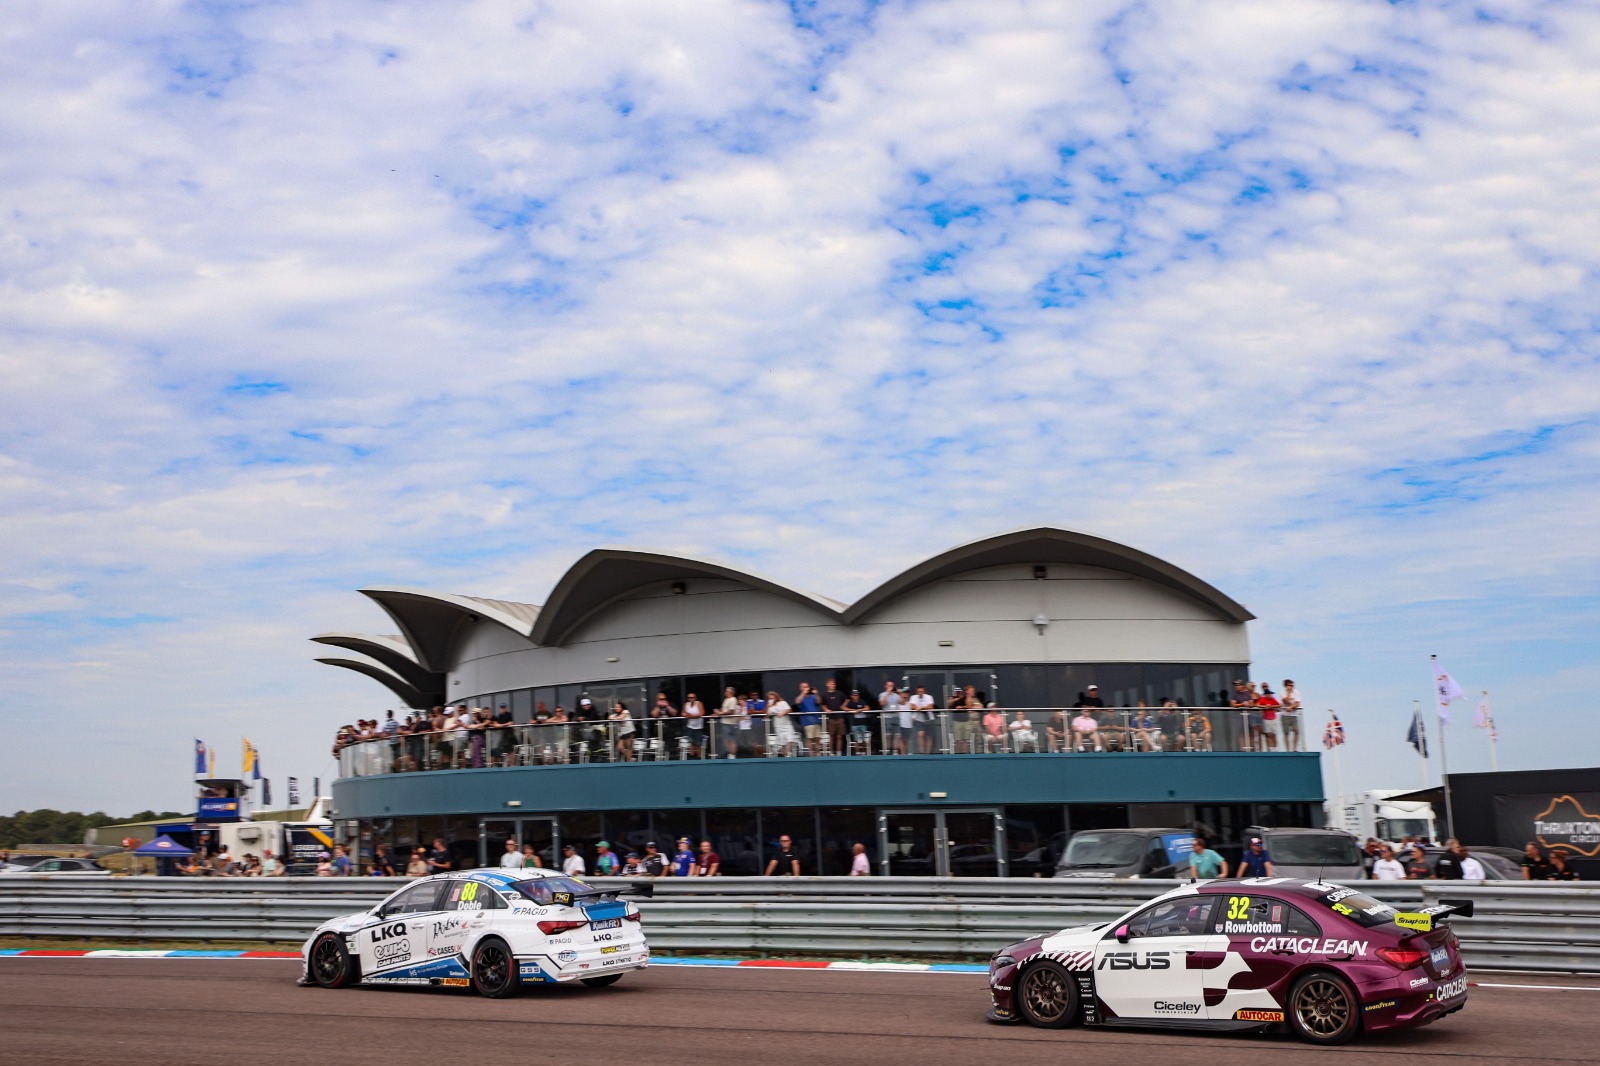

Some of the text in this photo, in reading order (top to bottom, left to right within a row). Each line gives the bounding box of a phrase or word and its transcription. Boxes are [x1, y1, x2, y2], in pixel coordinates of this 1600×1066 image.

[461, 882, 478, 901] 88
[458, 900, 482, 911] Doble
[520, 907, 548, 916] PAGID
[1227, 896, 1250, 920] 32
[371, 922, 408, 943] LKQ
[1225, 920, 1282, 934] Rowbottom
[593, 933, 612, 943] LKQ
[374, 938, 411, 960] euro
[1250, 936, 1369, 956] CATACLEAN
[378, 953, 411, 967] CAR PARTS
[1097, 951, 1171, 971] ASUS
[445, 978, 468, 986] AUTOCAR
[1154, 1000, 1202, 1015] Ciceley
[1364, 1000, 1396, 1012] GOODYEAR
[1239, 1010, 1282, 1021] AUTOCAR
